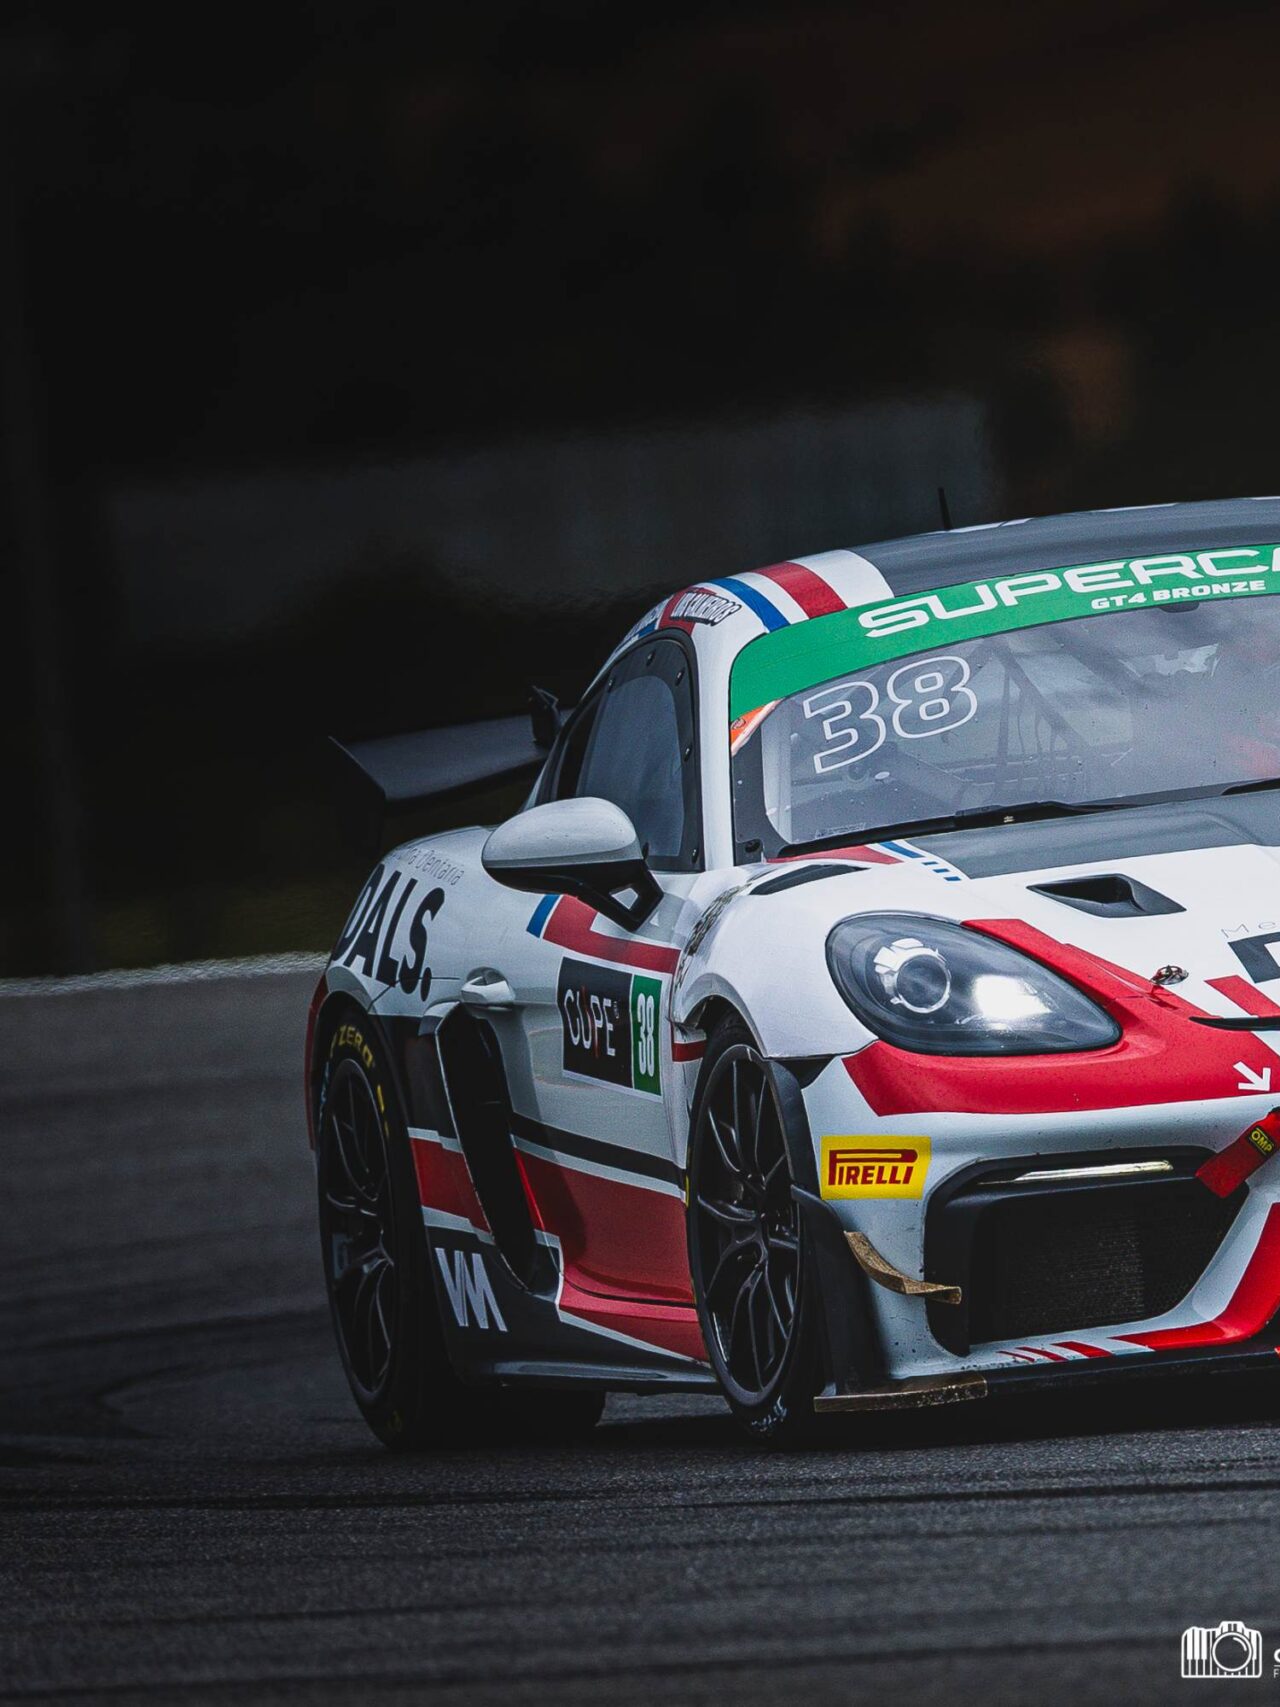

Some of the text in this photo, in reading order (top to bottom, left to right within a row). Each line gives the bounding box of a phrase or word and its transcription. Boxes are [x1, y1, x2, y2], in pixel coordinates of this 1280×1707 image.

[1091, 580, 1266, 610] GT4 BRONZE
[803, 656, 978, 774] 38
[331, 863, 446, 1002] DALS.
[637, 992, 655, 1078] 38
[828, 1149, 919, 1186] PIRELLI
[1251, 1129, 1274, 1153] OMP
